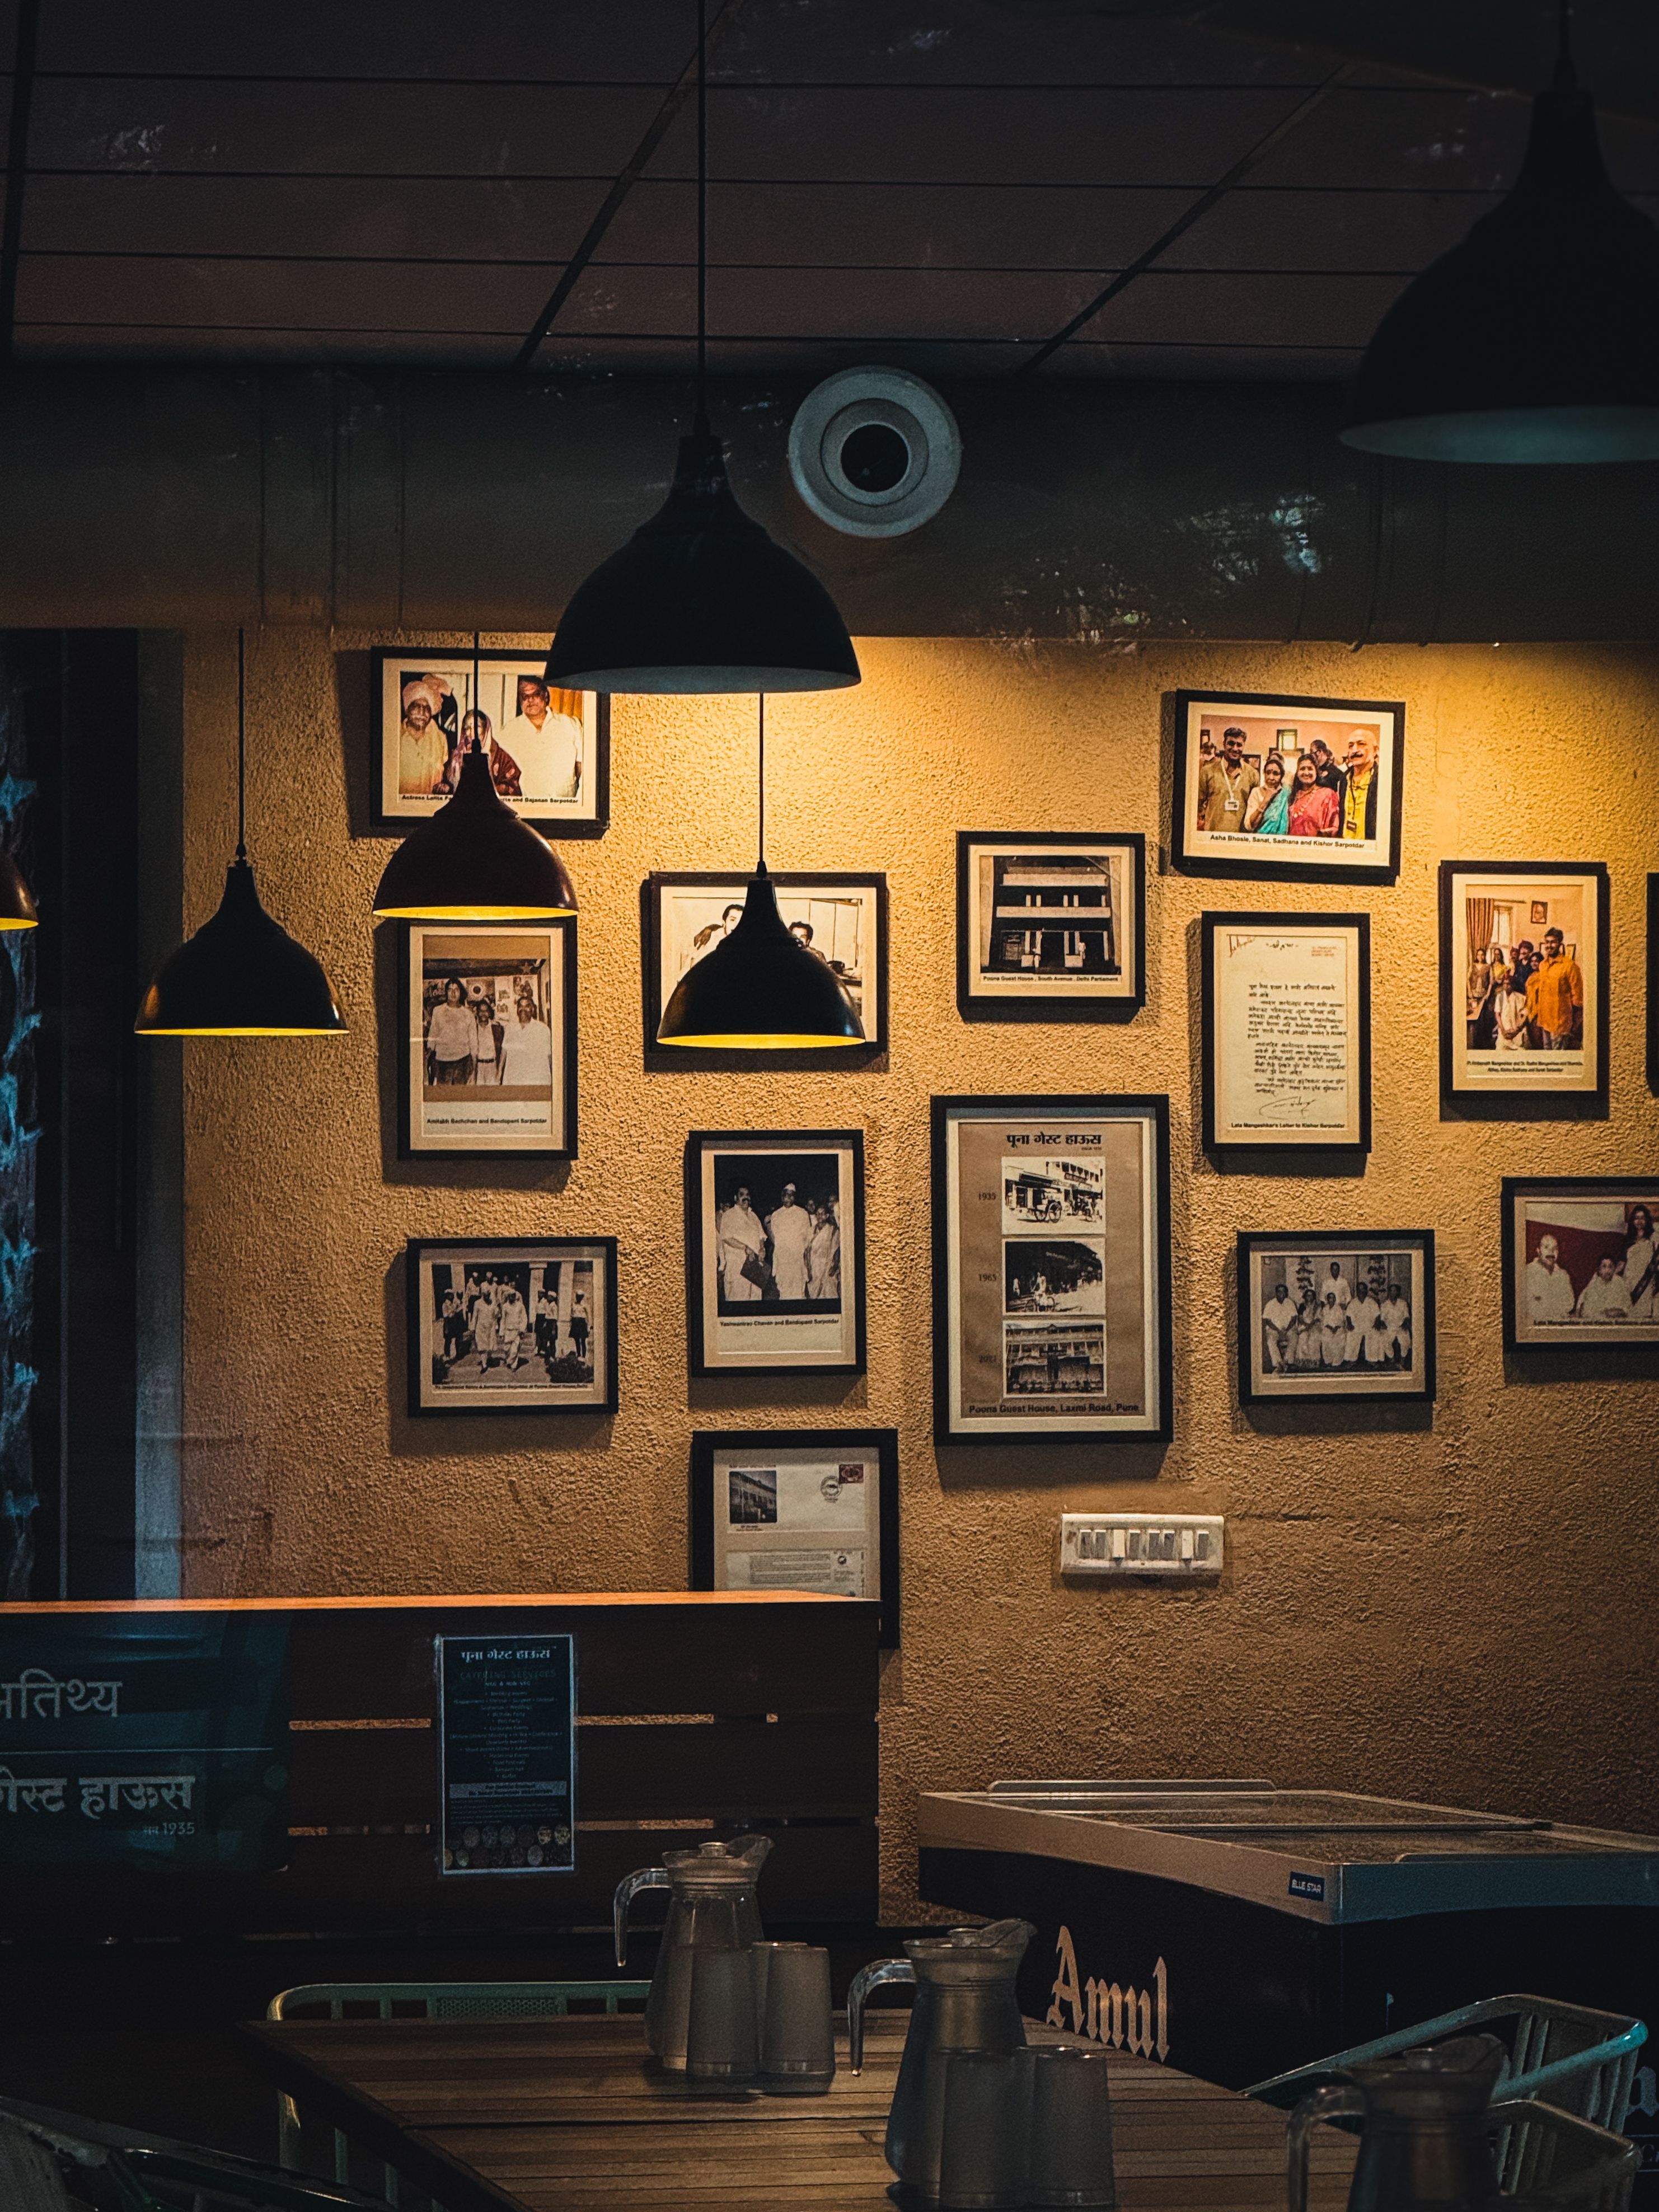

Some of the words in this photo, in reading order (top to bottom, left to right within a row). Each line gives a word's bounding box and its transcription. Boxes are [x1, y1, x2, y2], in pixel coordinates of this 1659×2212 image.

[1006, 1134, 1031, 1148] पूना
[1033, 1131, 1062, 1145] गेस्ट
[1065, 1134, 1102, 1145] हाऊस
[978, 1192, 996, 1201] 1935
[978, 1273, 997, 1282] 1965
[999, 1405, 1026, 1413] Guest
[1028, 1405, 1057, 1413] House,
[1088, 1404, 1114, 1413] Road,
[1116, 1403, 1140, 1412] Pune
[461, 1650, 484, 1663] पूना
[487, 1648, 513, 1661] गेस्ट
[78, 1775, 196, 1820] हाऊस
[162, 1821, 195, 1836] 1935
[1291, 1878, 1306, 1891] BLUE
[1306, 1882, 1321, 1895] STAR
[1046, 1924, 1171, 2065] Amul
